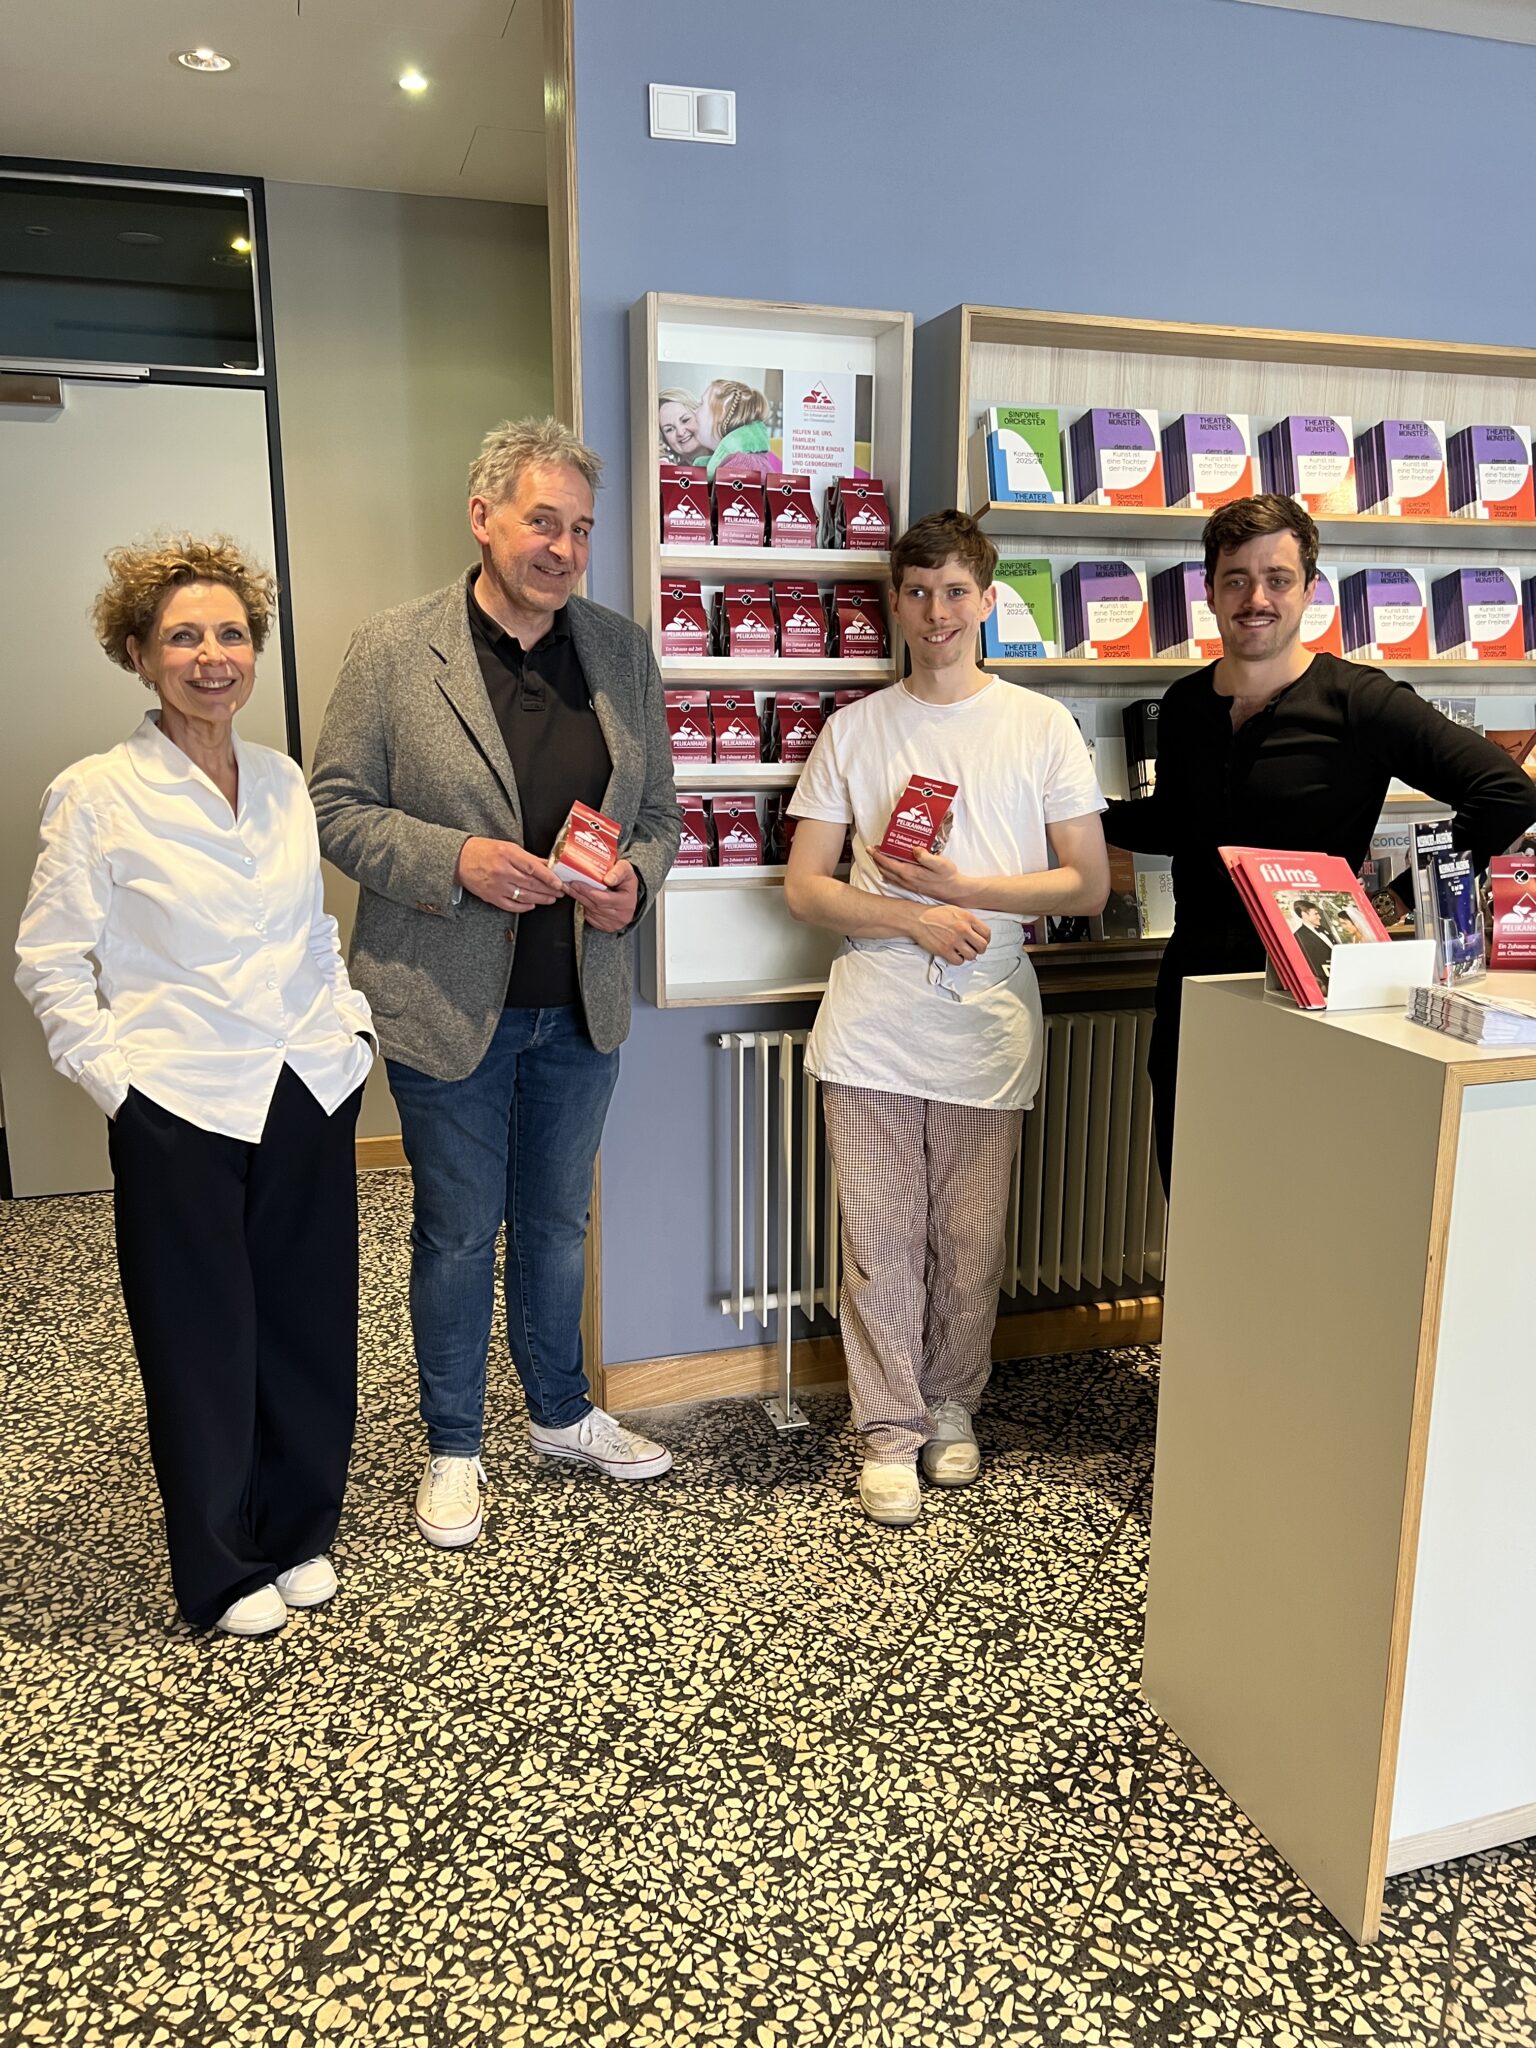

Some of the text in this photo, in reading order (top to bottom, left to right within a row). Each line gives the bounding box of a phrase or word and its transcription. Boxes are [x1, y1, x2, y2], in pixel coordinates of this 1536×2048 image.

[1004, 418, 1045, 426] ORCHESTER
[725, 516, 760, 524] PELIKANHAUS
[1005, 650, 1038, 658] MÜNSTER
[896, 818, 933, 834] PELIKANHAUS
[1260, 864, 1318, 882] films
